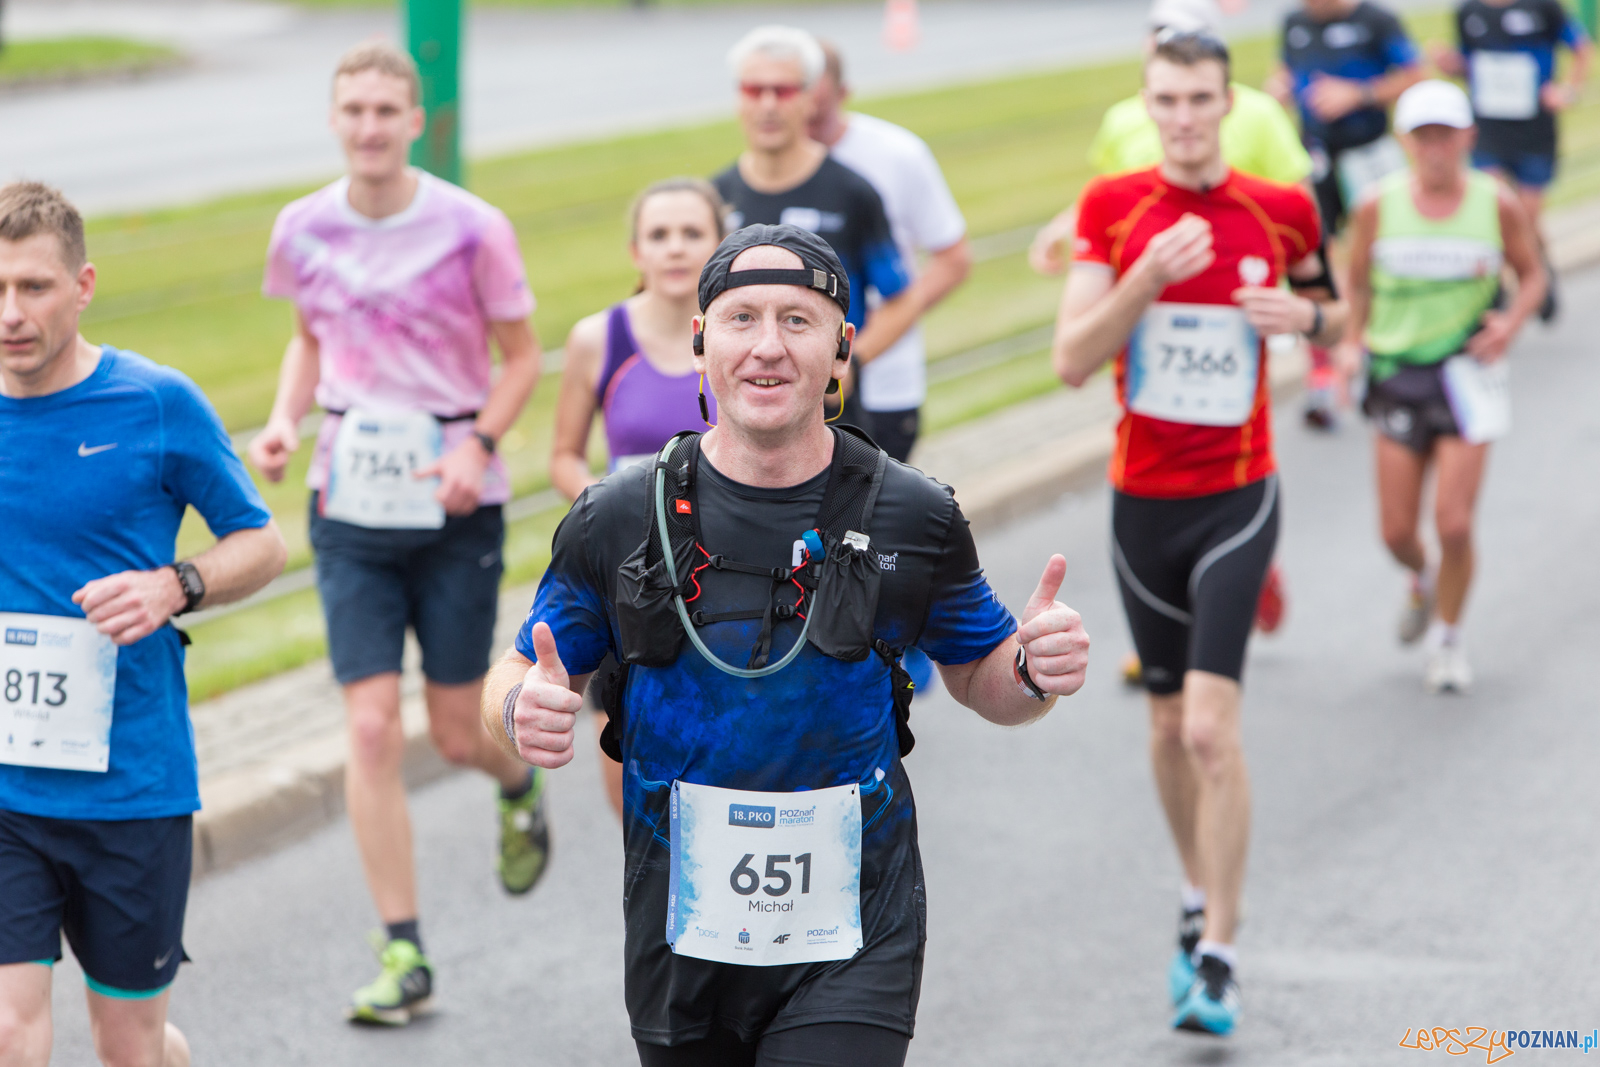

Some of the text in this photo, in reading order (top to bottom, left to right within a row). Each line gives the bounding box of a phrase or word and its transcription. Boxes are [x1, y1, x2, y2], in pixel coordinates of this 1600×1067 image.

[1160, 344, 1238, 376] 7366
[4, 668, 67, 707] 813
[732, 810, 772, 822] 18. PKO
[779, 815, 814, 825] maraton
[729, 852, 811, 897] 651
[748, 899, 794, 913] Michał
[772, 933, 791, 945] 4F
